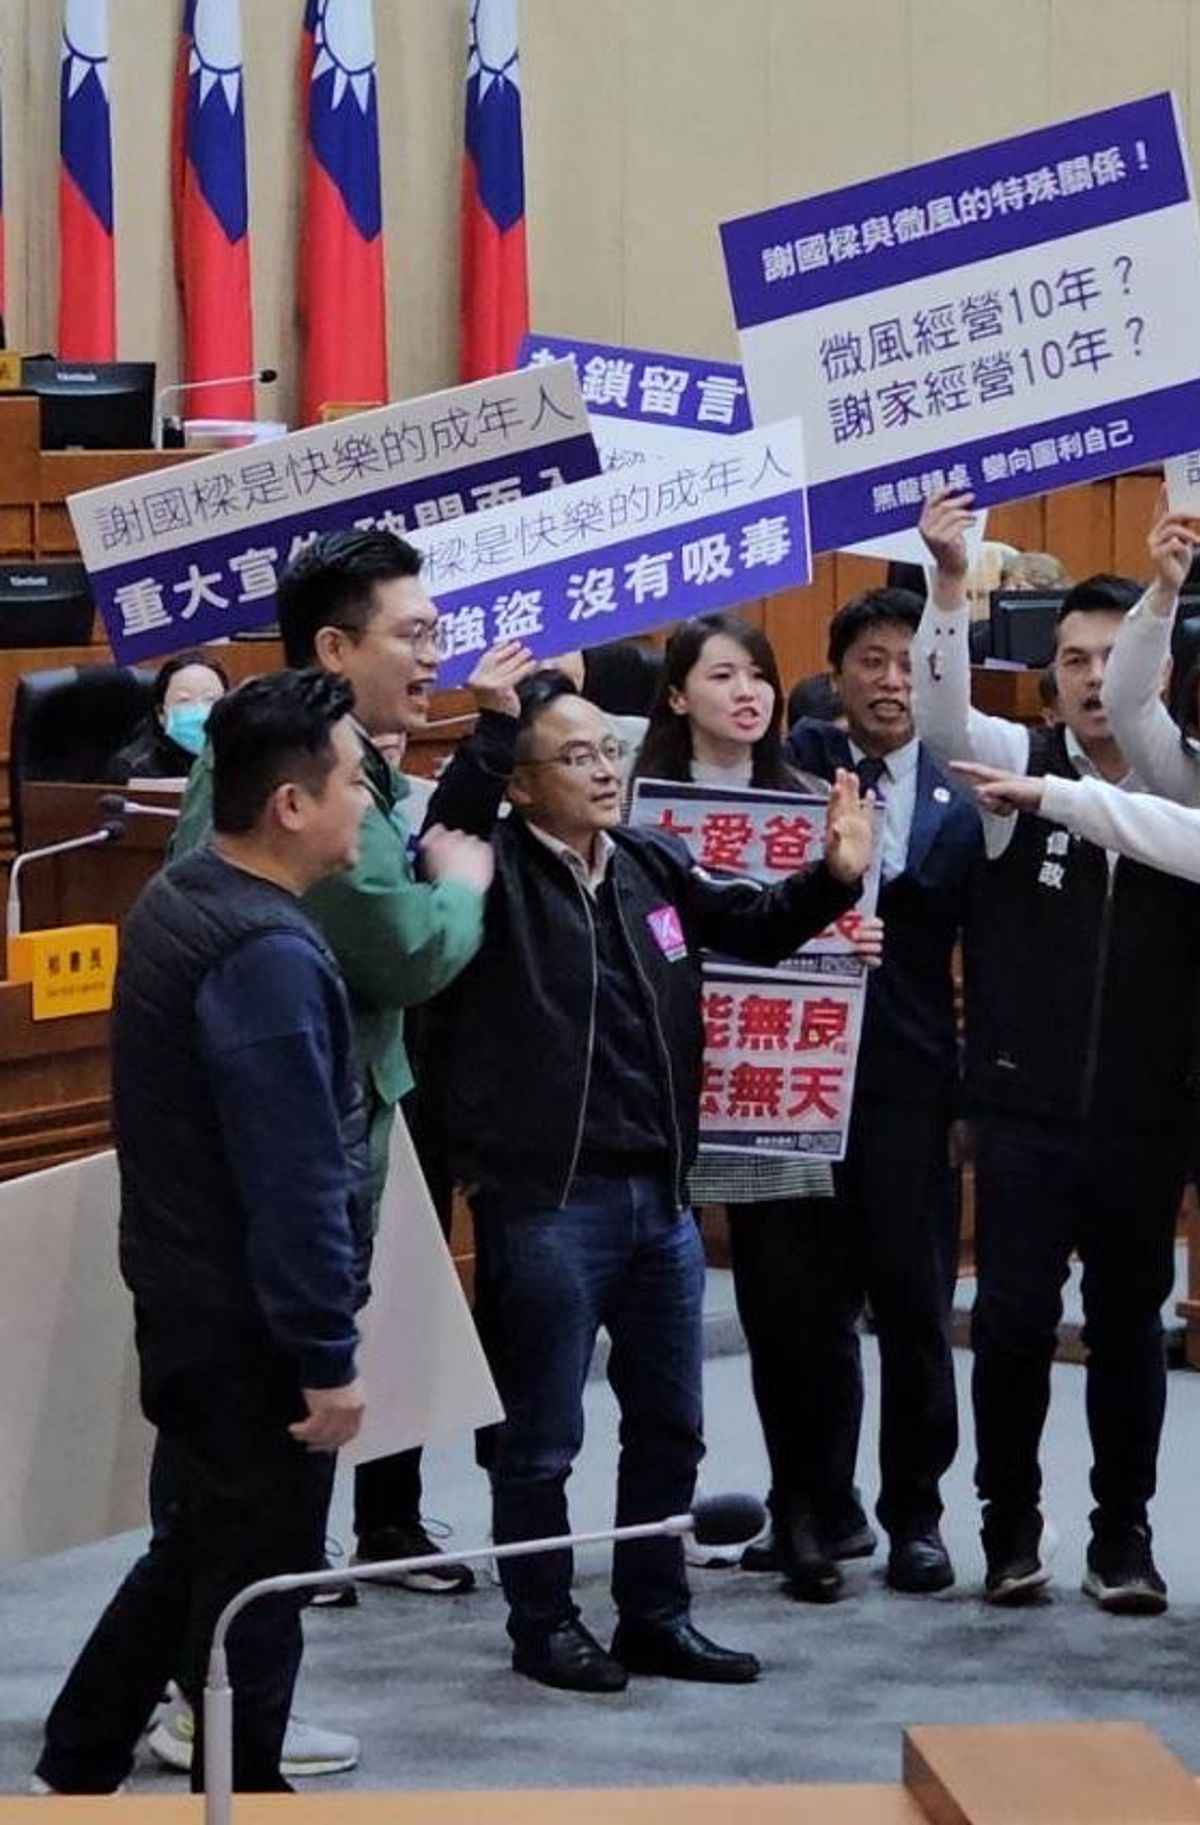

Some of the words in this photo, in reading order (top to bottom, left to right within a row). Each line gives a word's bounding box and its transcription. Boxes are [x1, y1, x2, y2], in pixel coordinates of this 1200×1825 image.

[819, 255, 1134, 382] 微風經營10年？
[828, 316, 1146, 445] 謝家經營10年？
[94, 384, 575, 551] 謝國樑是快樂的成年人
[113, 531, 317, 637] 重大宣
[567, 513, 793, 622] 沒有吸毒
